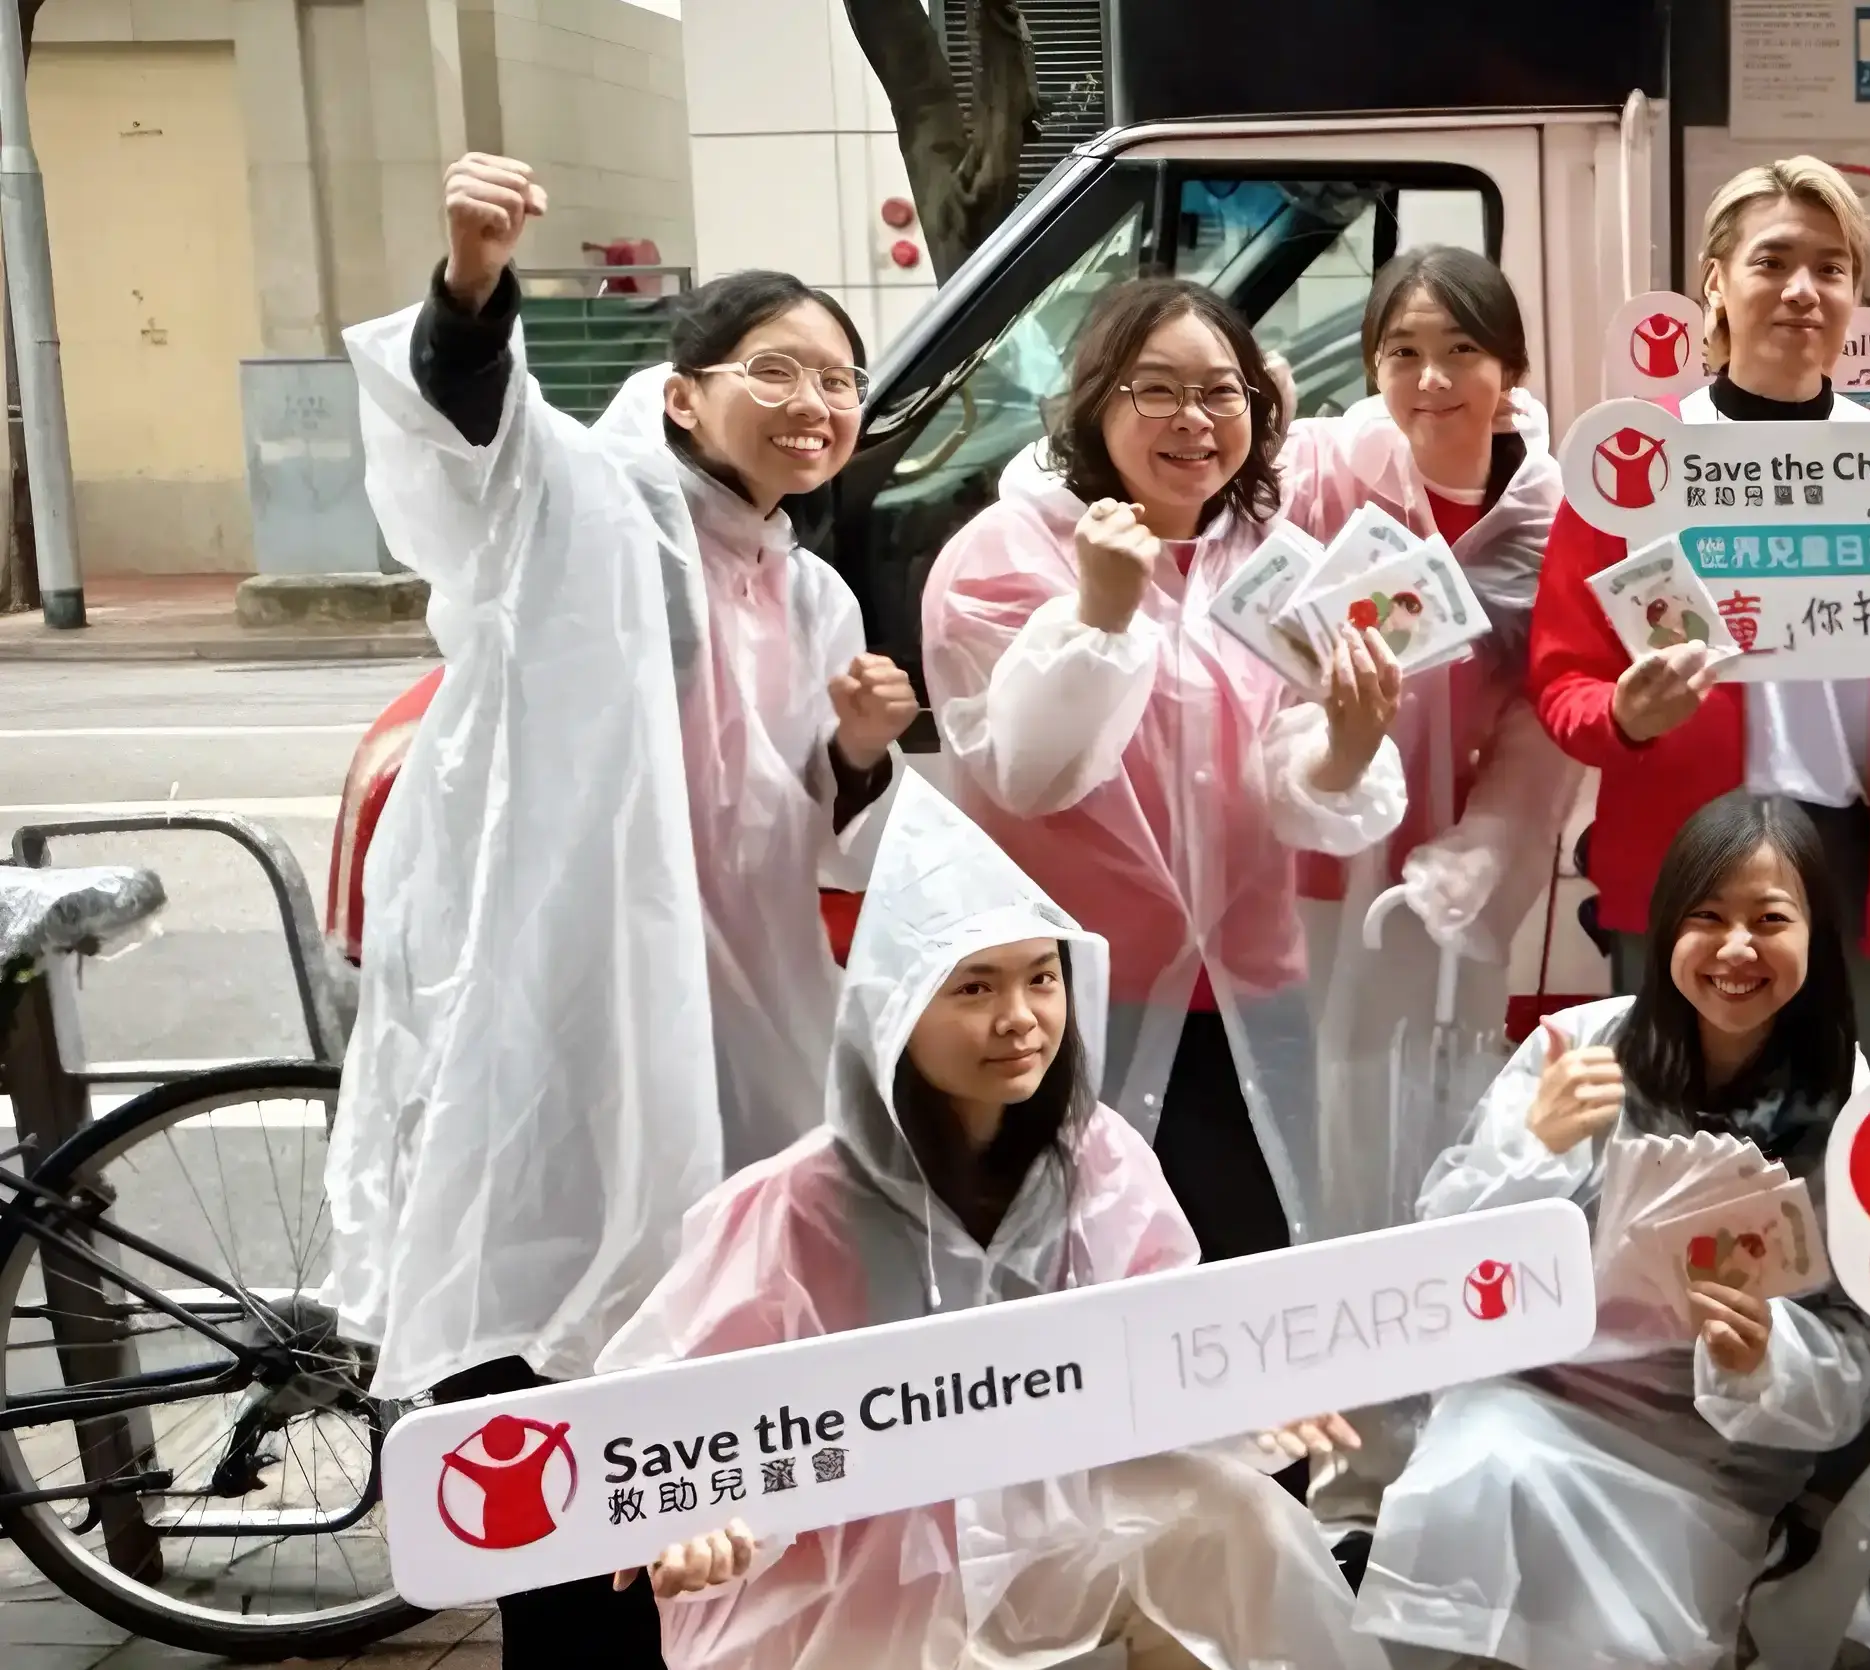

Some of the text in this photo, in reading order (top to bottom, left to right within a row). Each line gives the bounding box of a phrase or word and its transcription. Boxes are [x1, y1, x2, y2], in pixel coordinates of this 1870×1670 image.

[1683, 453, 1762, 482] Save
[1771, 453, 1824, 482] the
[1170, 1322, 1230, 1391] 15
[1241, 1277, 1451, 1374] YEARS
[603, 1361, 1084, 1485] Save the Children
